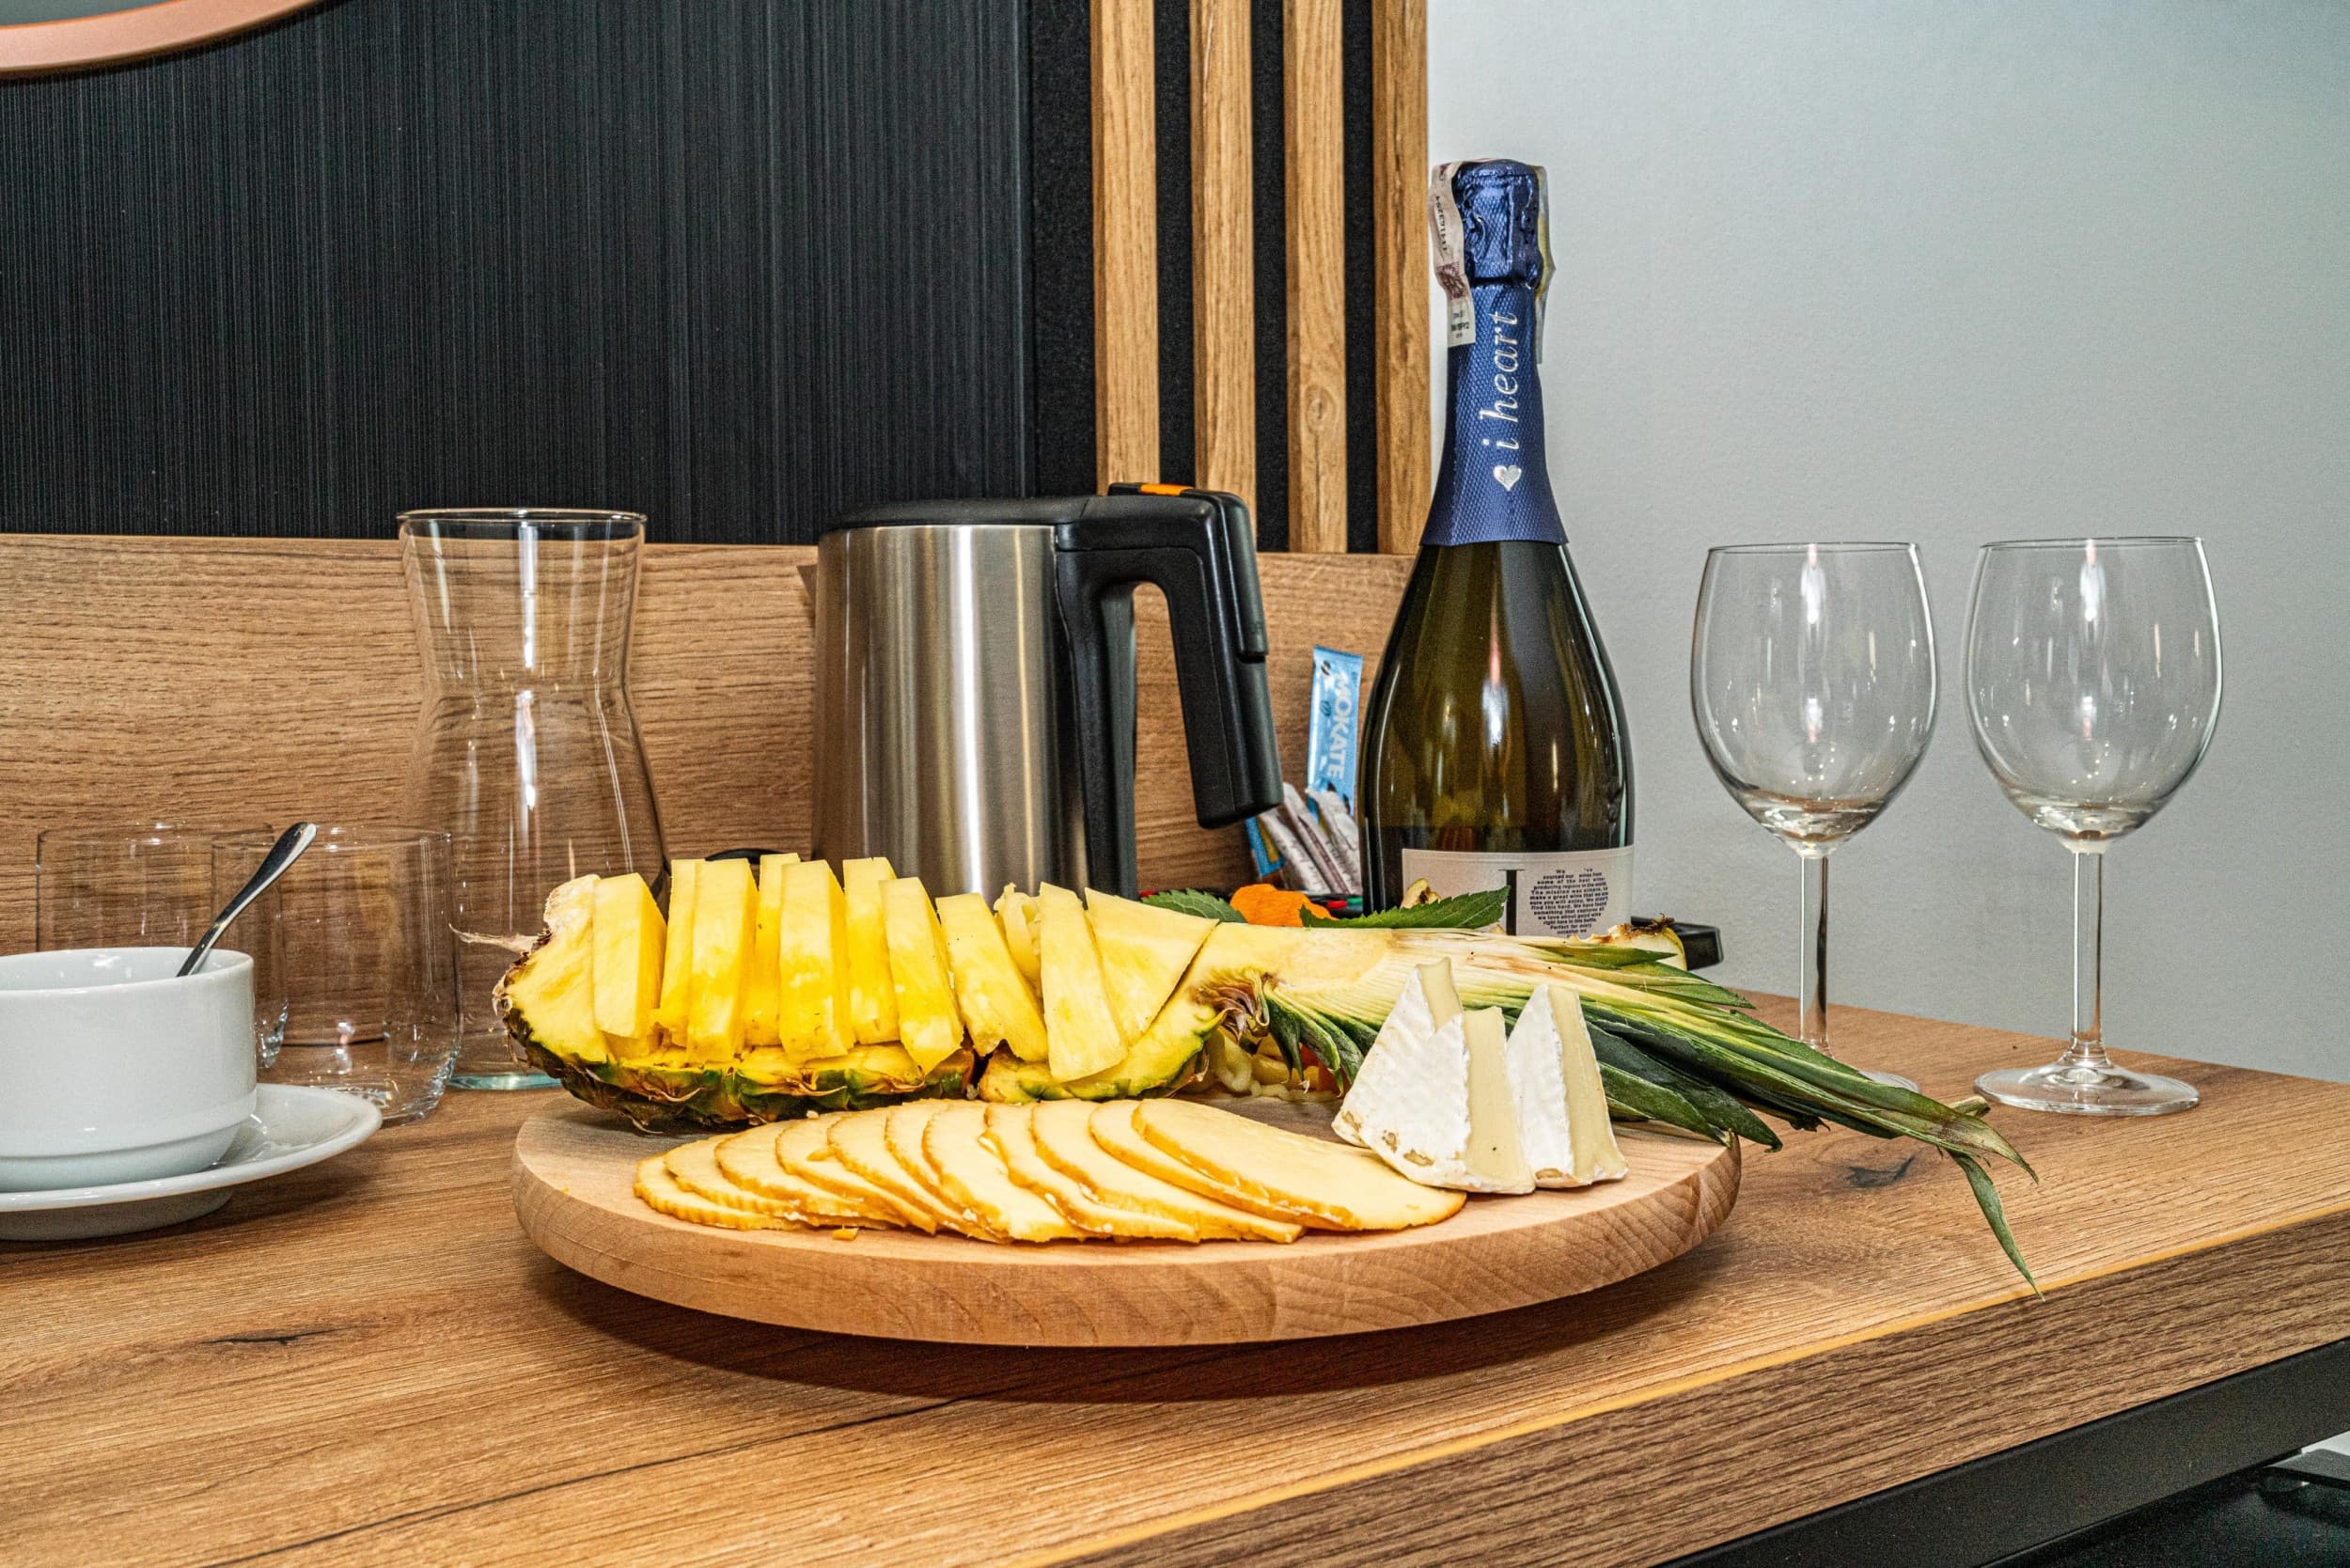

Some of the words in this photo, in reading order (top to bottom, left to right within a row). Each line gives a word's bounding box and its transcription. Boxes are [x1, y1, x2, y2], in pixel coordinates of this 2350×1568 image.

[1480, 311, 1519, 423] heart
[1482, 437, 1519, 450] i
[1327, 670, 1352, 780] MOKATE
